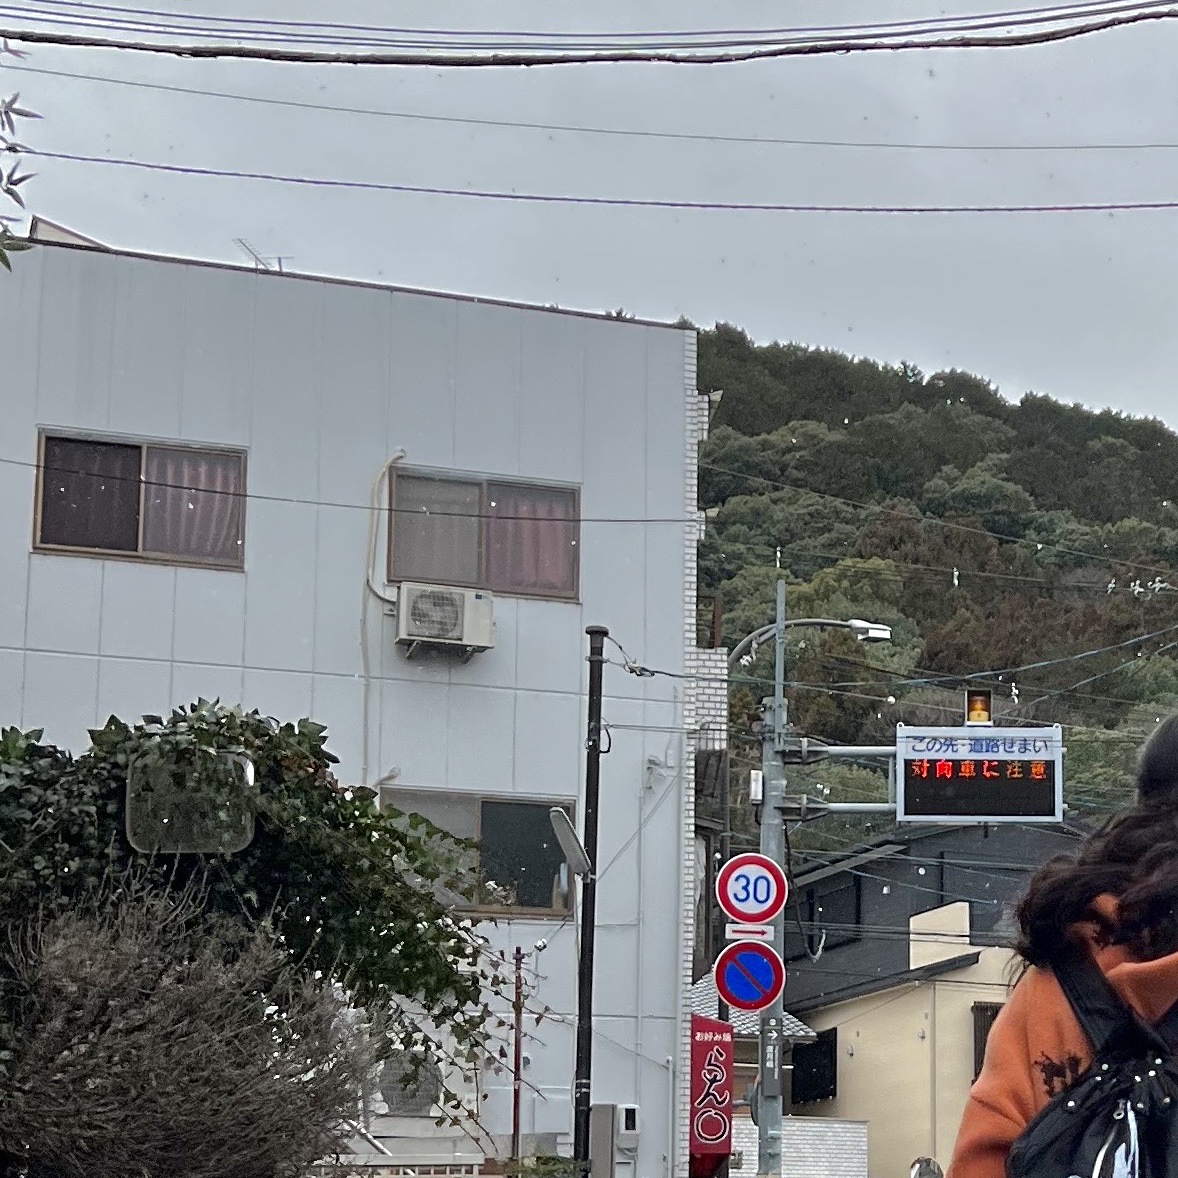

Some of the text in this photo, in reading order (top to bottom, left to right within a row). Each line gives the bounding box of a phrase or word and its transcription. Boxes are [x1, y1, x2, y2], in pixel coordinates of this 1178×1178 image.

[911, 759, 1048, 779] 対向車に注意
[733, 874, 770, 904] 30
